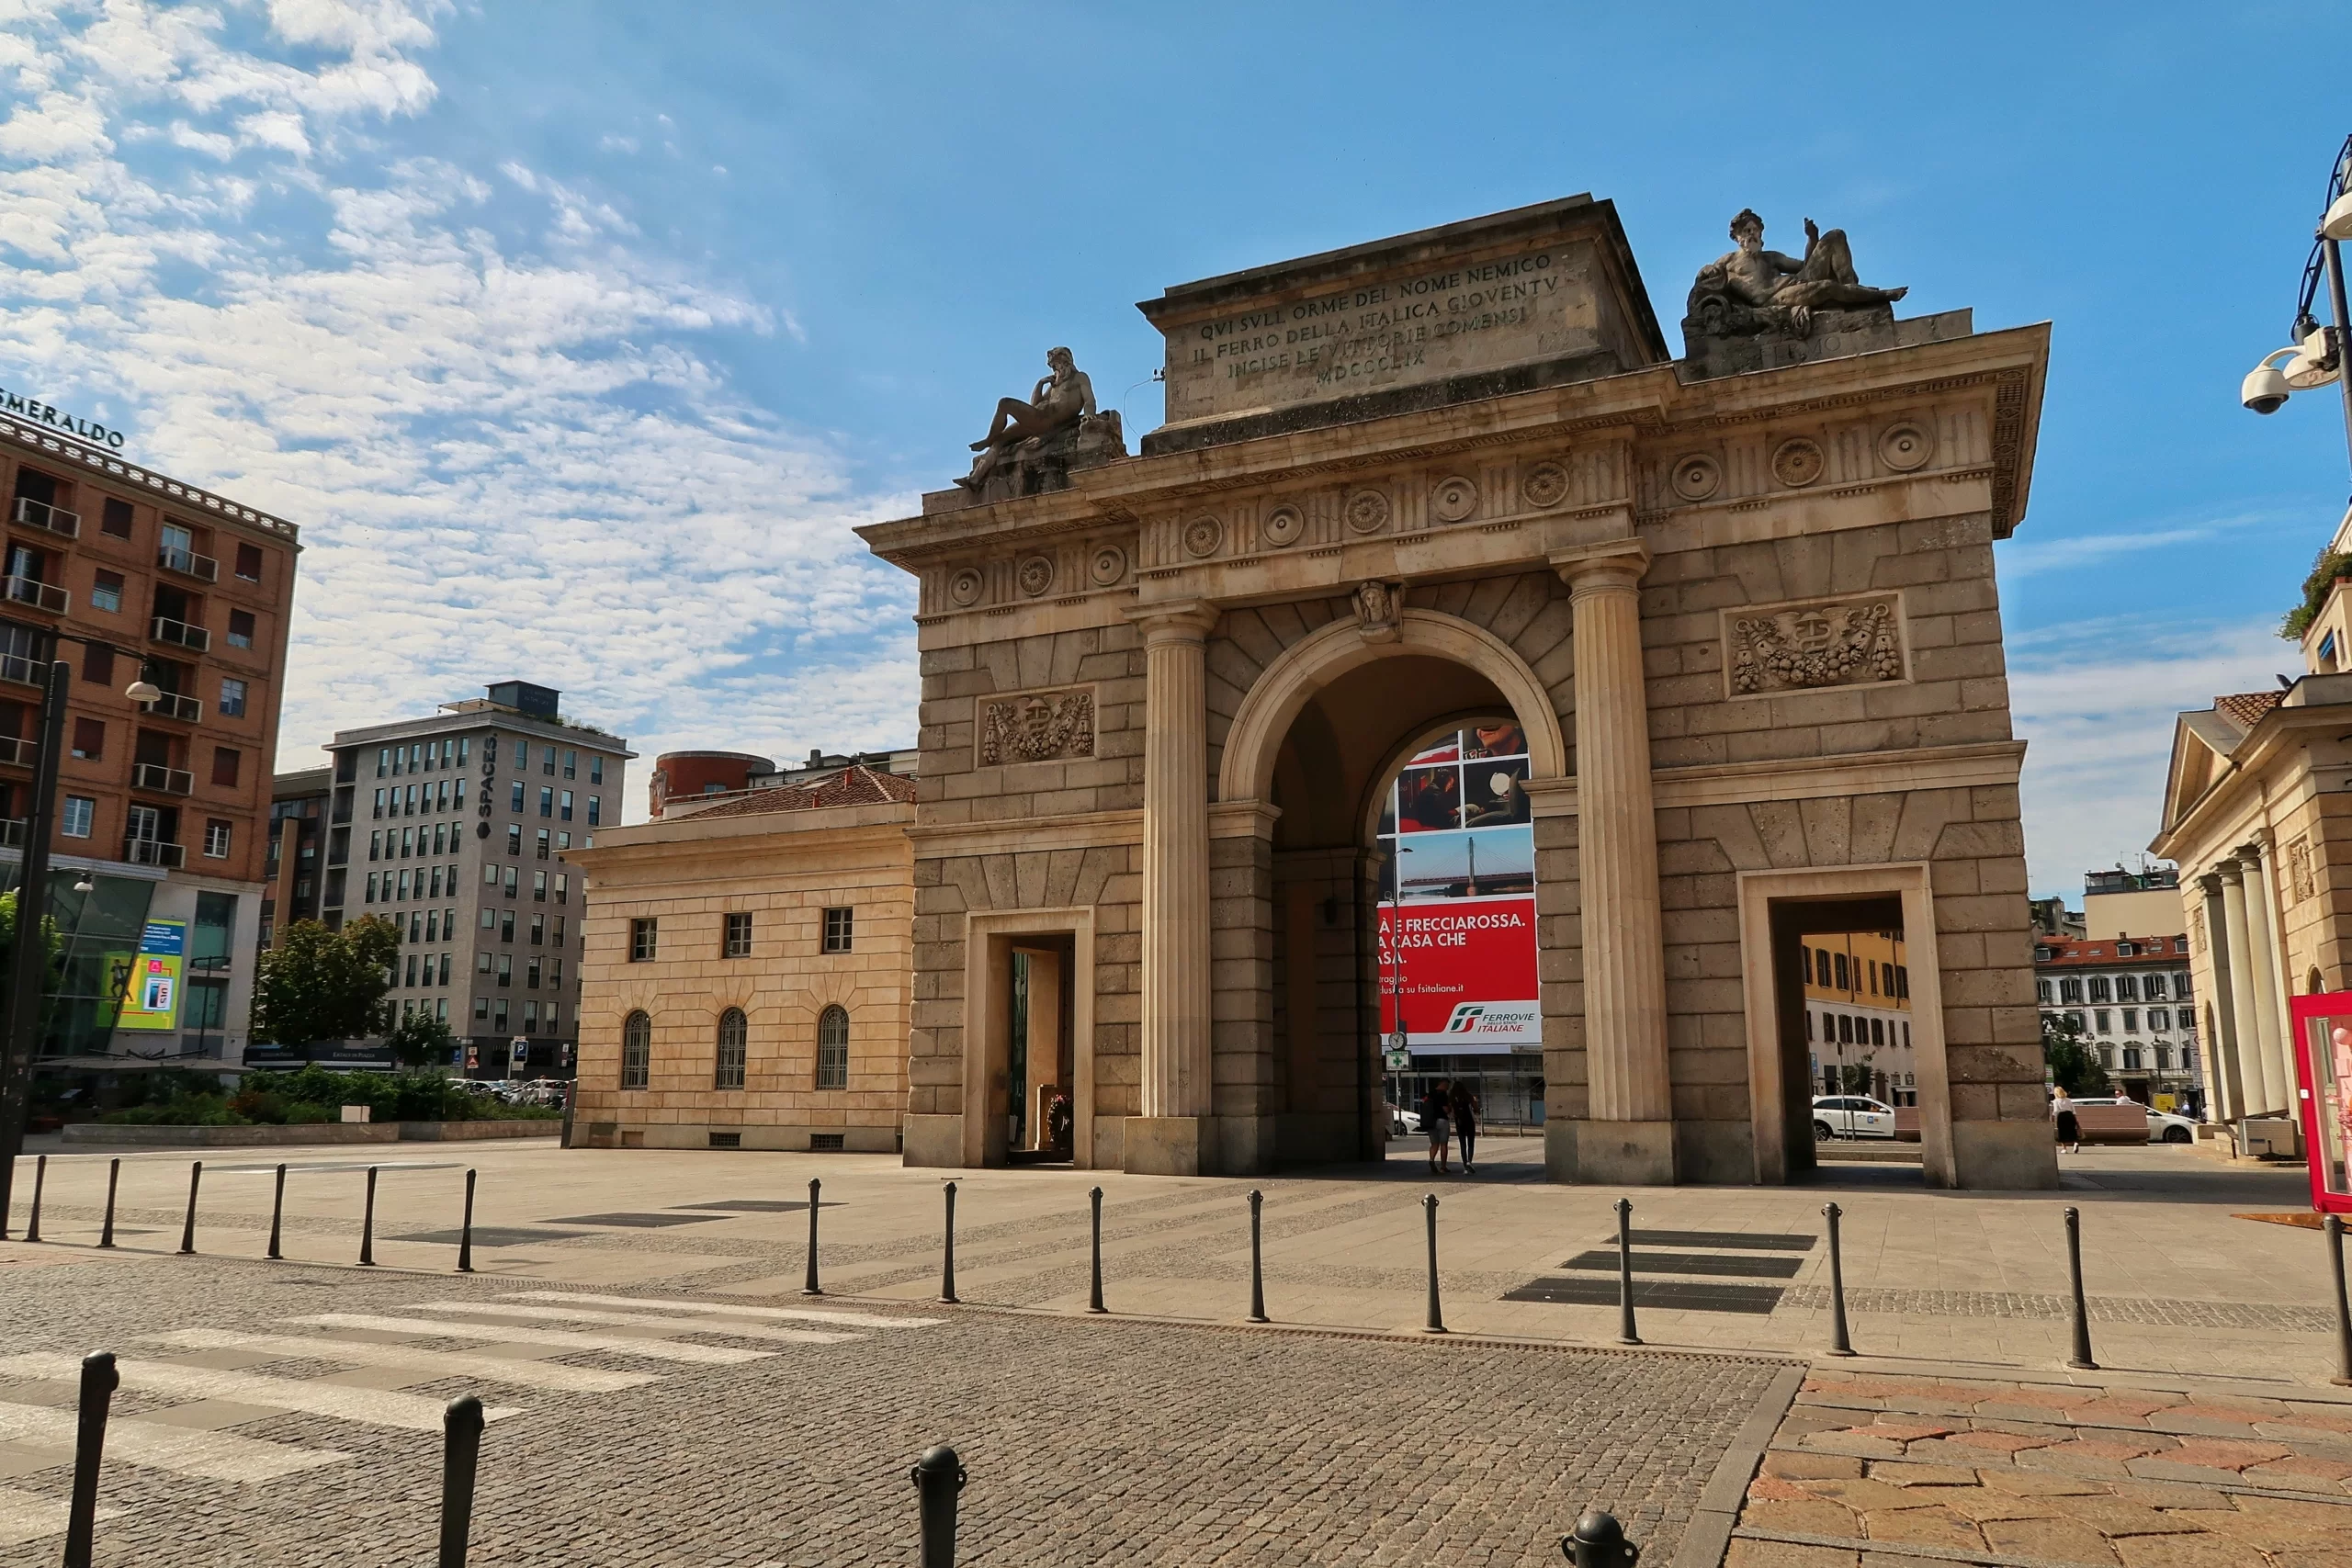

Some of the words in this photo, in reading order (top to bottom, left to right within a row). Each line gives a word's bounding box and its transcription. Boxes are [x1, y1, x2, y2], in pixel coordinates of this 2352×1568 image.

[1201, 322, 1234, 341] QVI
[1240, 310, 1286, 333] SVLL
[1293, 297, 1350, 320] ORME
[1355, 289, 1393, 308] DEL
[1399, 273, 1461, 299] NOME
[1467, 254, 1551, 285] NEMICO
[1193, 349, 1211, 363] IL
[1216, 333, 1280, 358] FERRO
[1286, 319, 1351, 344] DELLA
[1359, 300, 1440, 330] ITALICA
[1447, 276, 1559, 312] GIOVENTV
[1227, 354, 1289, 378] INCISE
[1296, 347, 1320, 365] LE
[1328, 324, 1427, 359] VITTORIE
[1433, 306, 1528, 338] COMENSI
[1317, 351, 1427, 384] MDCCCLIX
[1406, 913, 1526, 932] FRECCIAROSSA.
[1391, 933, 1433, 949] CASA
[1437, 932, 1466, 946] CHE
[1418, 984, 1464, 993] fsitaliane.it
[1482, 1013, 1535, 1021] FERROVIE
[1477, 1024, 1524, 1033] ITALIANE
